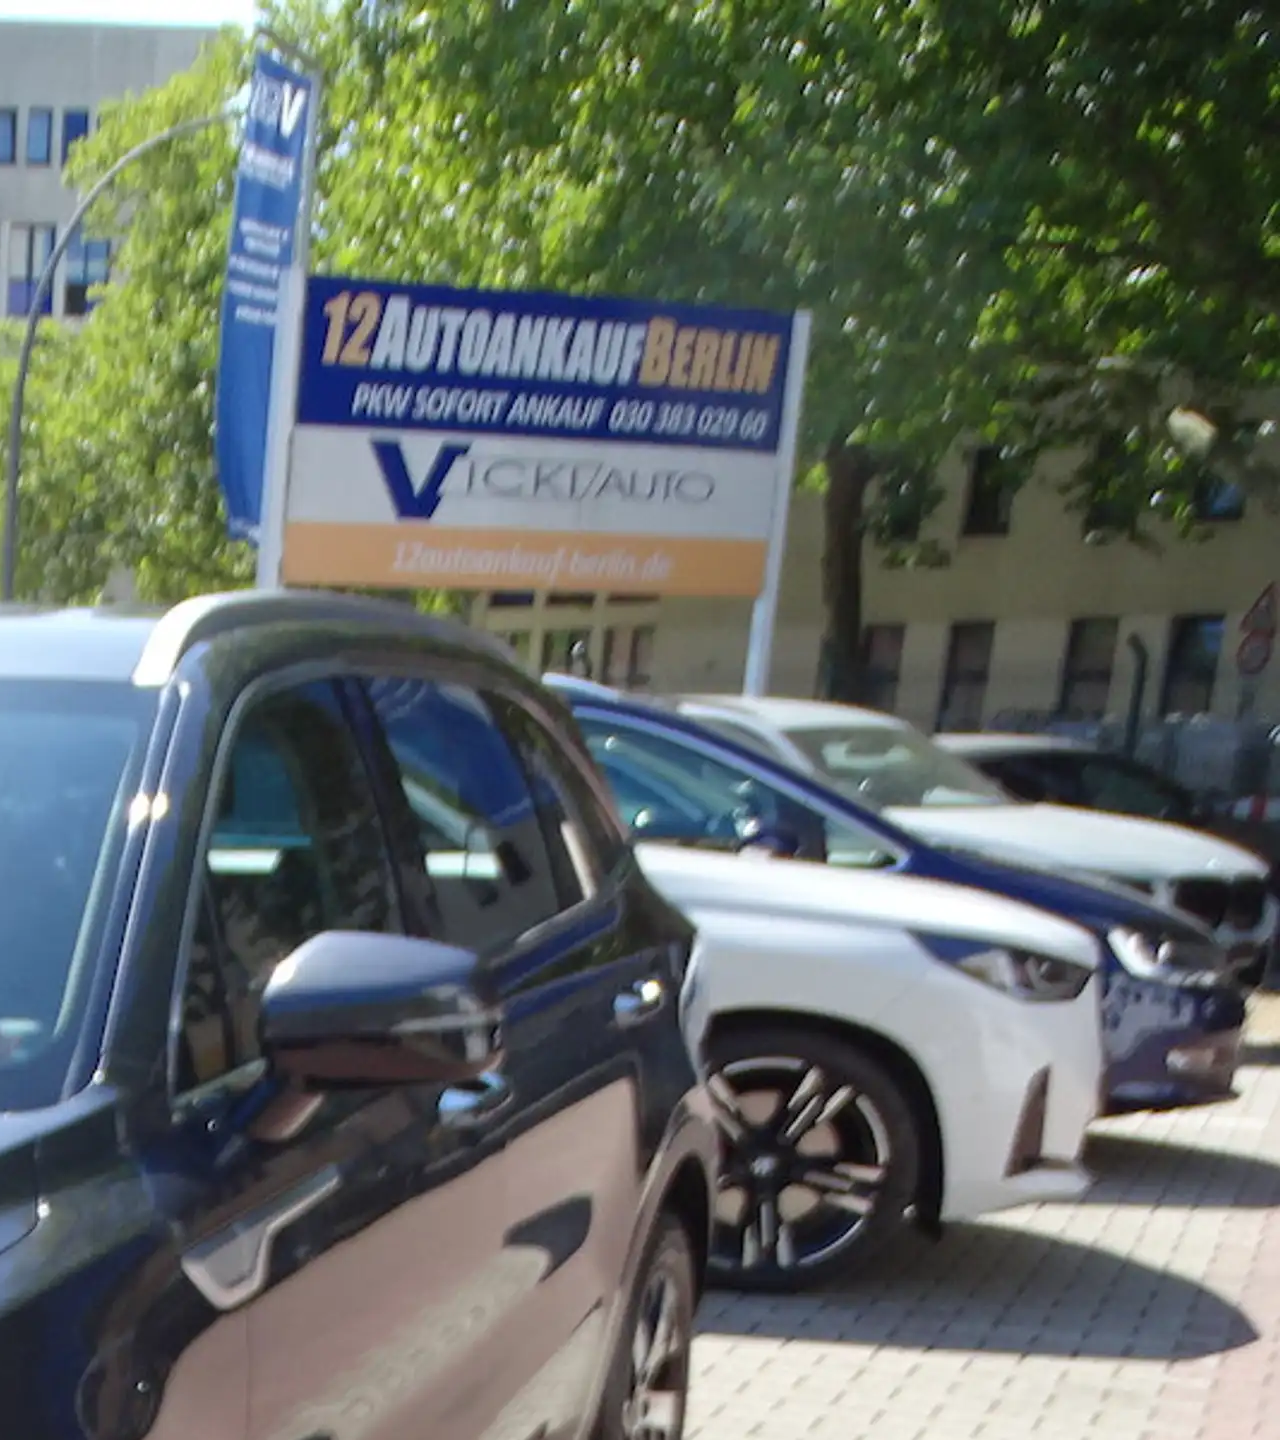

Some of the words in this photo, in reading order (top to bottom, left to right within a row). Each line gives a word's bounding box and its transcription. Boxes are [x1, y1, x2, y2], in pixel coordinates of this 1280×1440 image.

[351, 383, 414, 419] PKW
[412, 386, 510, 423] SOFORT
[506, 397, 605, 429] ANKAUF
[608, 400, 650, 433] 030
